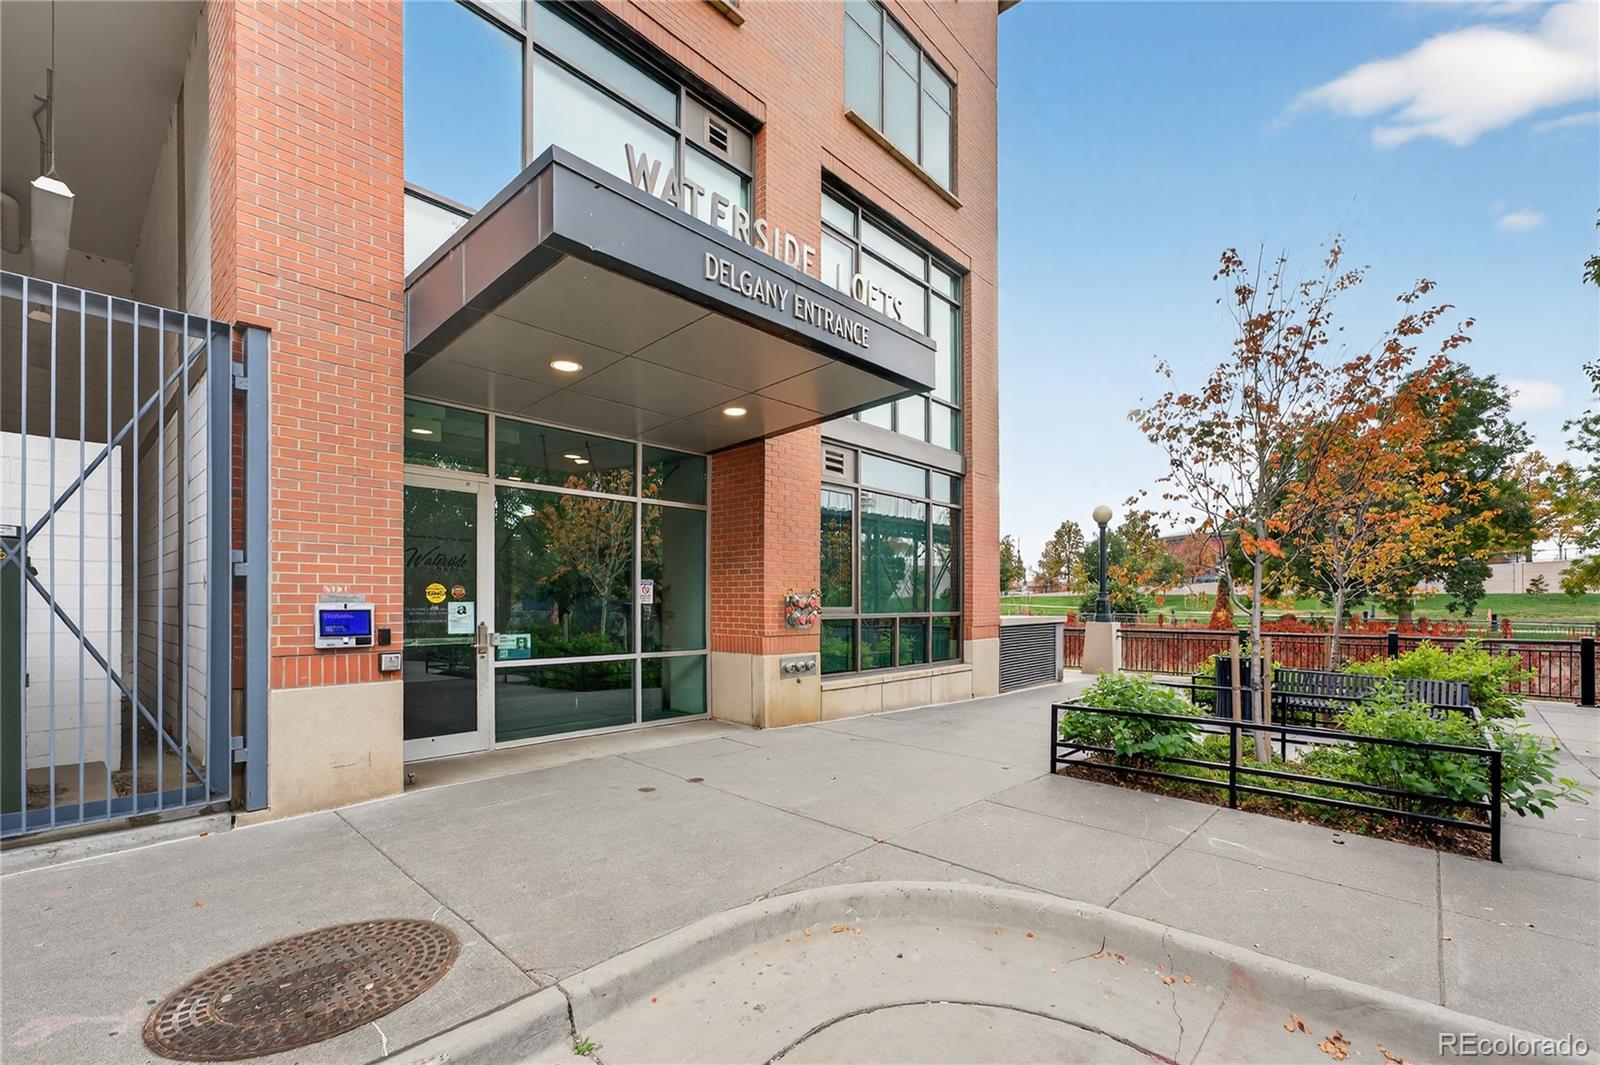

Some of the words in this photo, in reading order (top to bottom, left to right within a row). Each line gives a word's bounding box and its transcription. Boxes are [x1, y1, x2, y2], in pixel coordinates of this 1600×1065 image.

[625, 143, 817, 277] WATERSIDE
[704, 251, 789, 311] DELGANY
[794, 292, 870, 348] ENTRANCE
